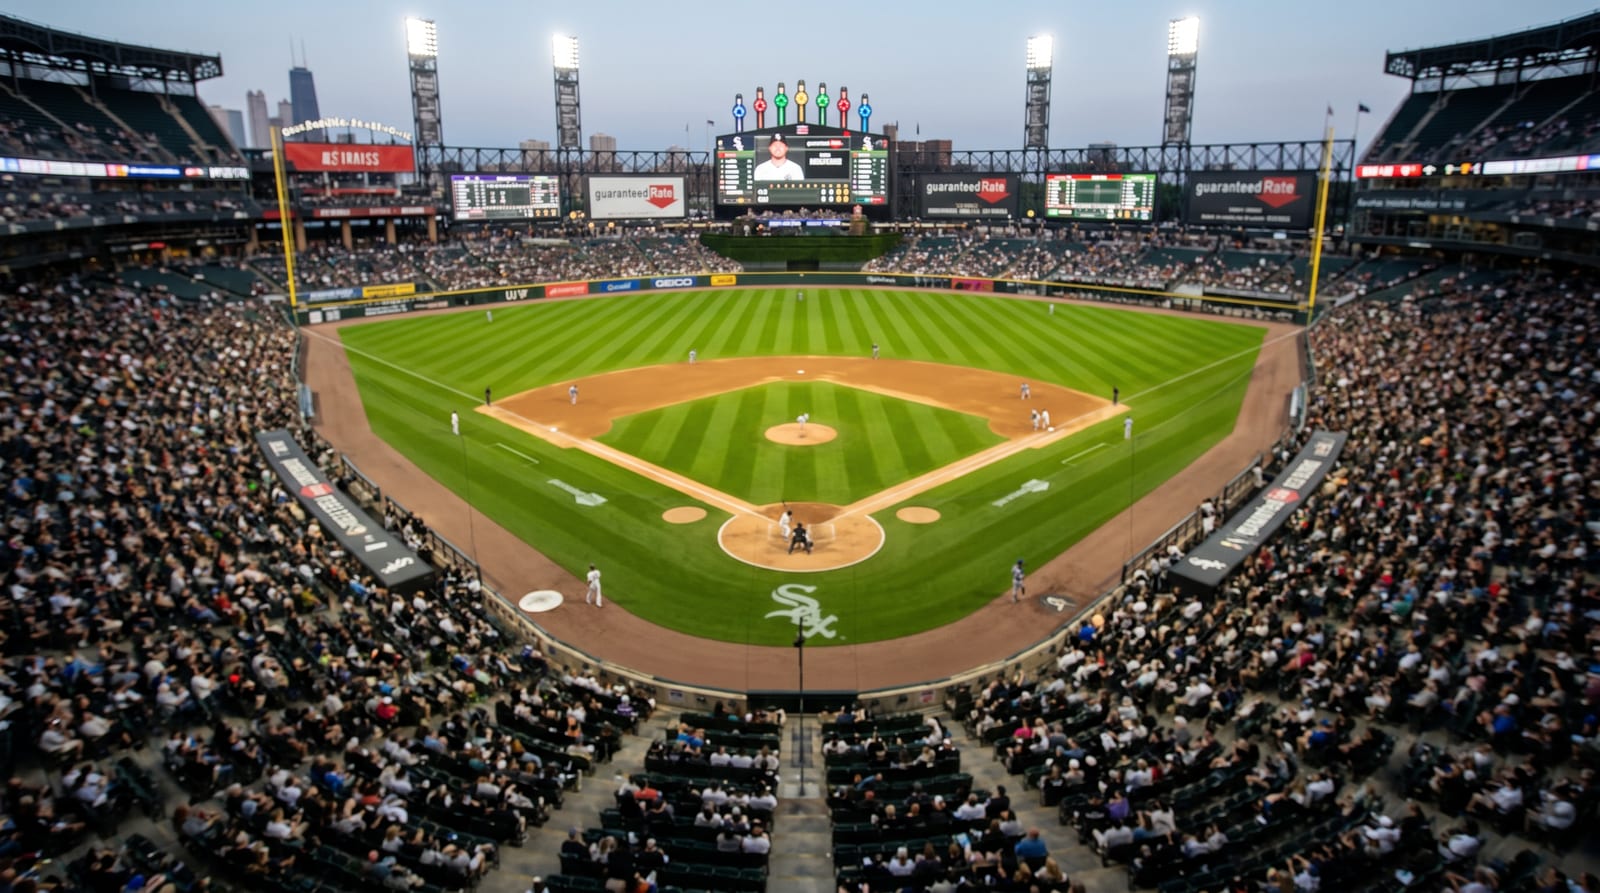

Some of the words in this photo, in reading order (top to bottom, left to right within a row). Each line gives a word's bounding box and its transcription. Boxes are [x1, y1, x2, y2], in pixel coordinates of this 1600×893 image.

[595, 188, 648, 201] guaranteed
[650, 187, 673, 198] Rate
[926, 181, 980, 195] guaranteed
[981, 180, 1005, 192] Rate
[1194, 180, 1262, 196] guaranteed
[1263, 179, 1294, 194] Rate
[655, 277, 692, 288] GEICO
